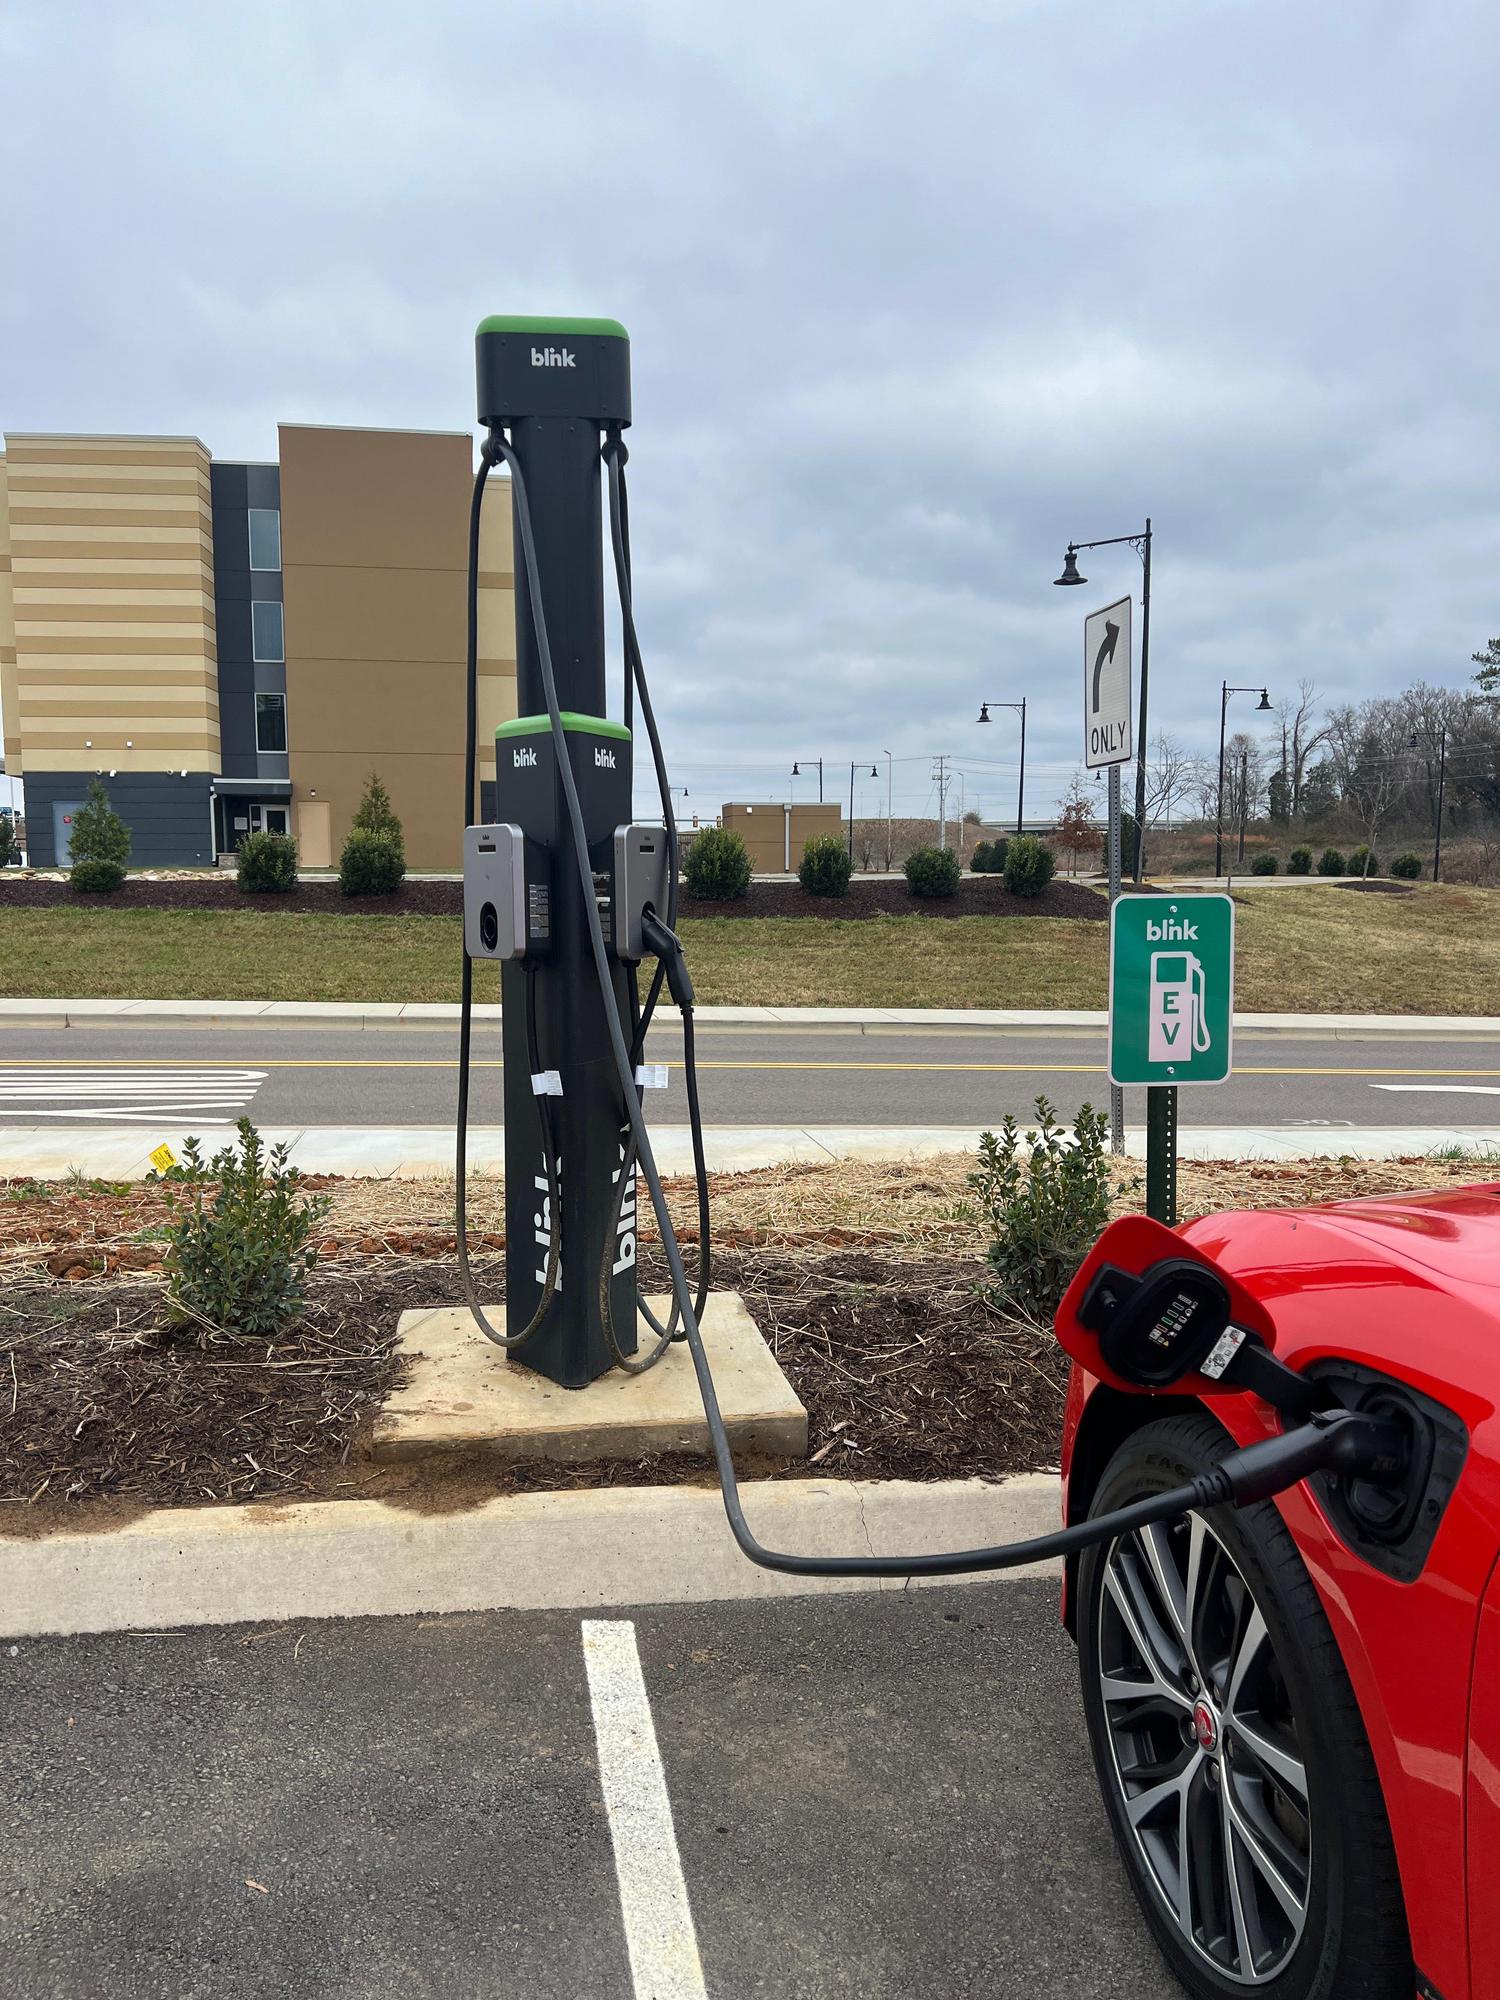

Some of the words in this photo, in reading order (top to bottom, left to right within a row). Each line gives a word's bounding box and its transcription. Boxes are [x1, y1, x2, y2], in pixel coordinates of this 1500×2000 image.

[531, 347, 576, 367] blink
[1091, 721, 1126, 755] ONLY
[513, 747, 537, 767] blink
[594, 747, 616, 769] blink
[1146, 918, 1199, 941] blink
